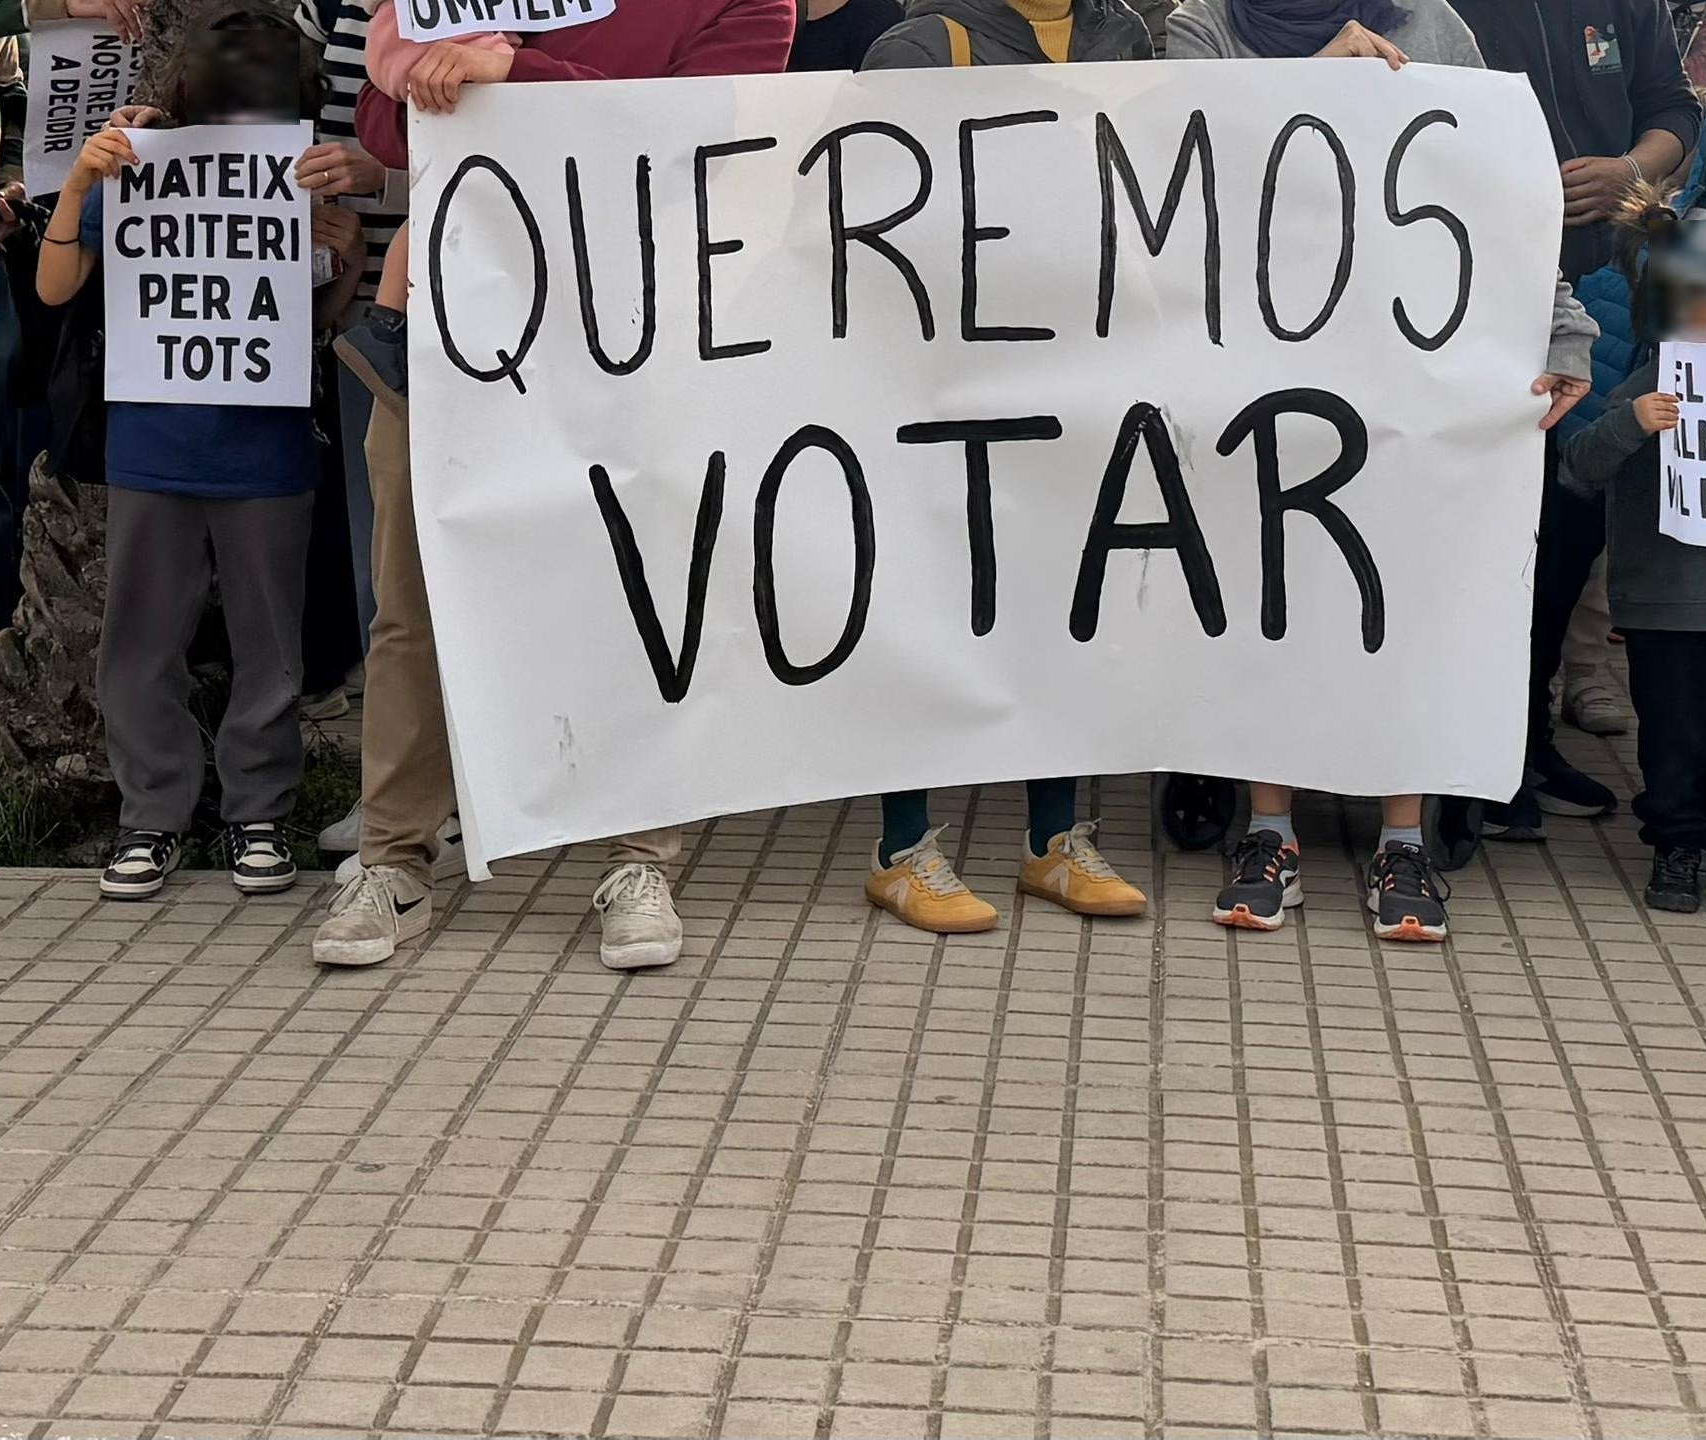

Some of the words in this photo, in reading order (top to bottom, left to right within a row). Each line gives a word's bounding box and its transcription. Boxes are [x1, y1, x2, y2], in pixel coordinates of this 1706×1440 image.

[51, 55, 81, 71] A
[86, 35, 122, 115] NOSTRE
[44, 79, 80, 153] DECIDIR
[120, 153, 294, 204] MATEIX
[115, 213, 299, 262] CRITERI
[429, 108, 1473, 394] QUEREMOS
[139, 273, 231, 320] PER
[247, 275, 279, 322] A
[157, 335, 271, 383] TOTS
[589, 388, 1386, 704] VOTAR
